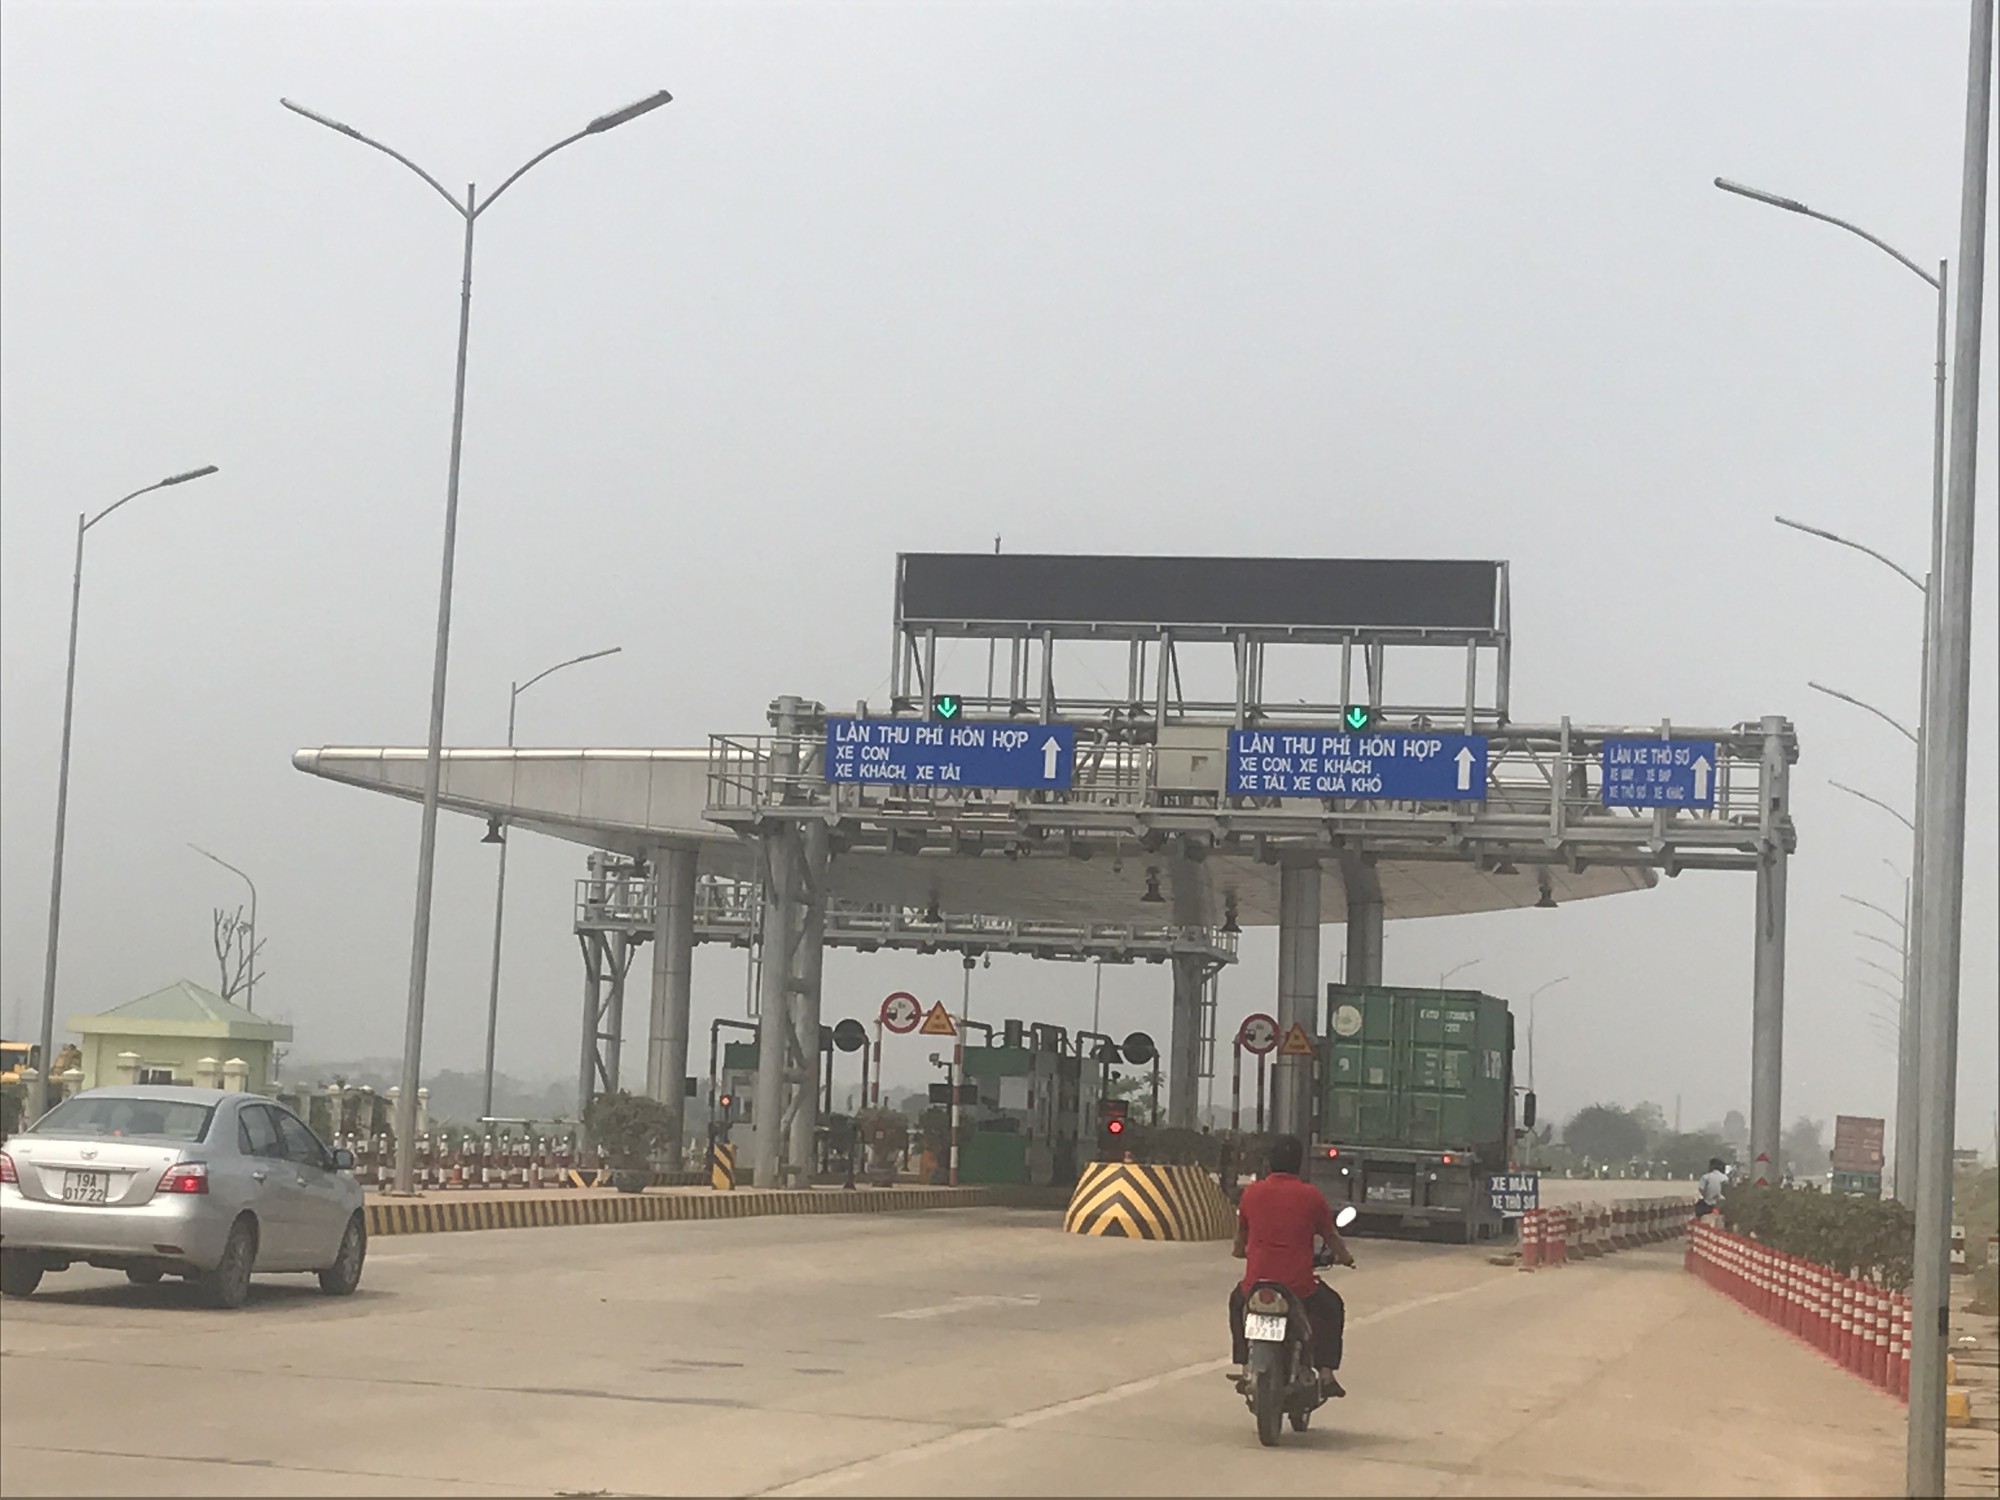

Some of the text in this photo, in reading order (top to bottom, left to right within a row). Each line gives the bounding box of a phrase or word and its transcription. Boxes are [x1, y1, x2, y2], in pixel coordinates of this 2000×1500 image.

[836, 722, 870, 743] LÀN
[878, 726, 909, 744] THU
[915, 724, 944, 746] PHÍ
[992, 730, 1029, 752] HỢP
[835, 745, 890, 761] XE CON
[1239, 733, 1274, 754] LÀN
[1282, 737, 1316, 754] THU
[1322, 735, 1350, 755] PHÍ
[1403, 740, 1442, 762] HỢP
[1610, 744, 1631, 764] LÀN
[1633, 748, 1647, 764] XE
[834, 763, 852, 778] XE
[916, 765, 934, 780] XE
[939, 763, 961, 781] TẢI
[1239, 757, 1258, 772] XE
[1299, 758, 1318, 773] XE
[1324, 757, 1372, 774] KHÁCH
[1239, 775, 1258, 789] XE
[1293, 776, 1311, 790] XE
[1316, 774, 1346, 791] QUÁ
[77, 1173, 96, 1187] 19A
[1491, 1176, 1506, 1191] XE
[1491, 1195, 1503, 1209] XE
